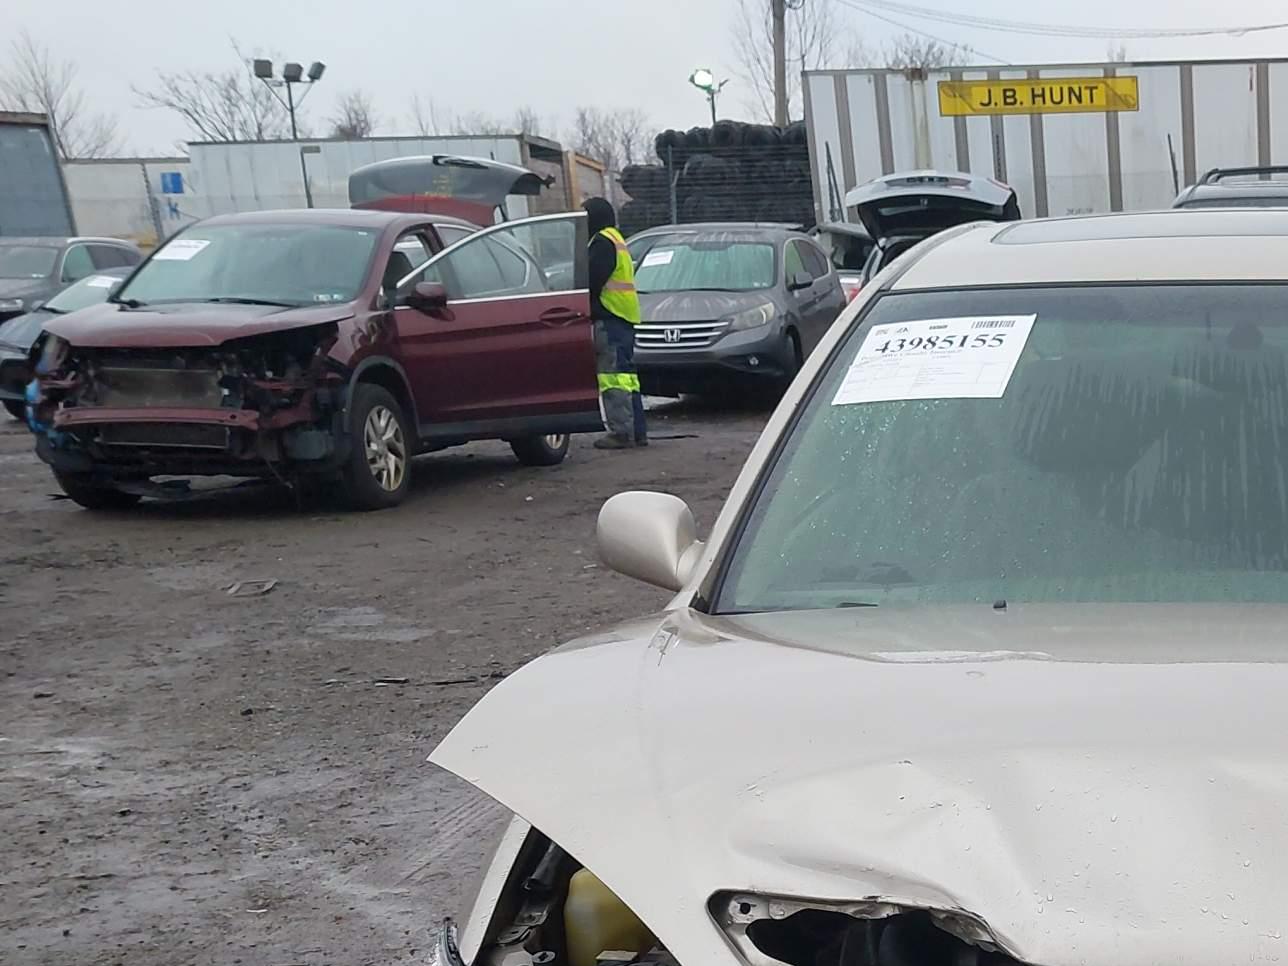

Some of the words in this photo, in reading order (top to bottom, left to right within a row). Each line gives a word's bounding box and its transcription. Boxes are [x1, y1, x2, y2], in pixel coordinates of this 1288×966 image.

[979, 88, 1024, 107] J.B.
[1031, 85, 1098, 106] HUNT
[875, 333, 1007, 354] 43985155
